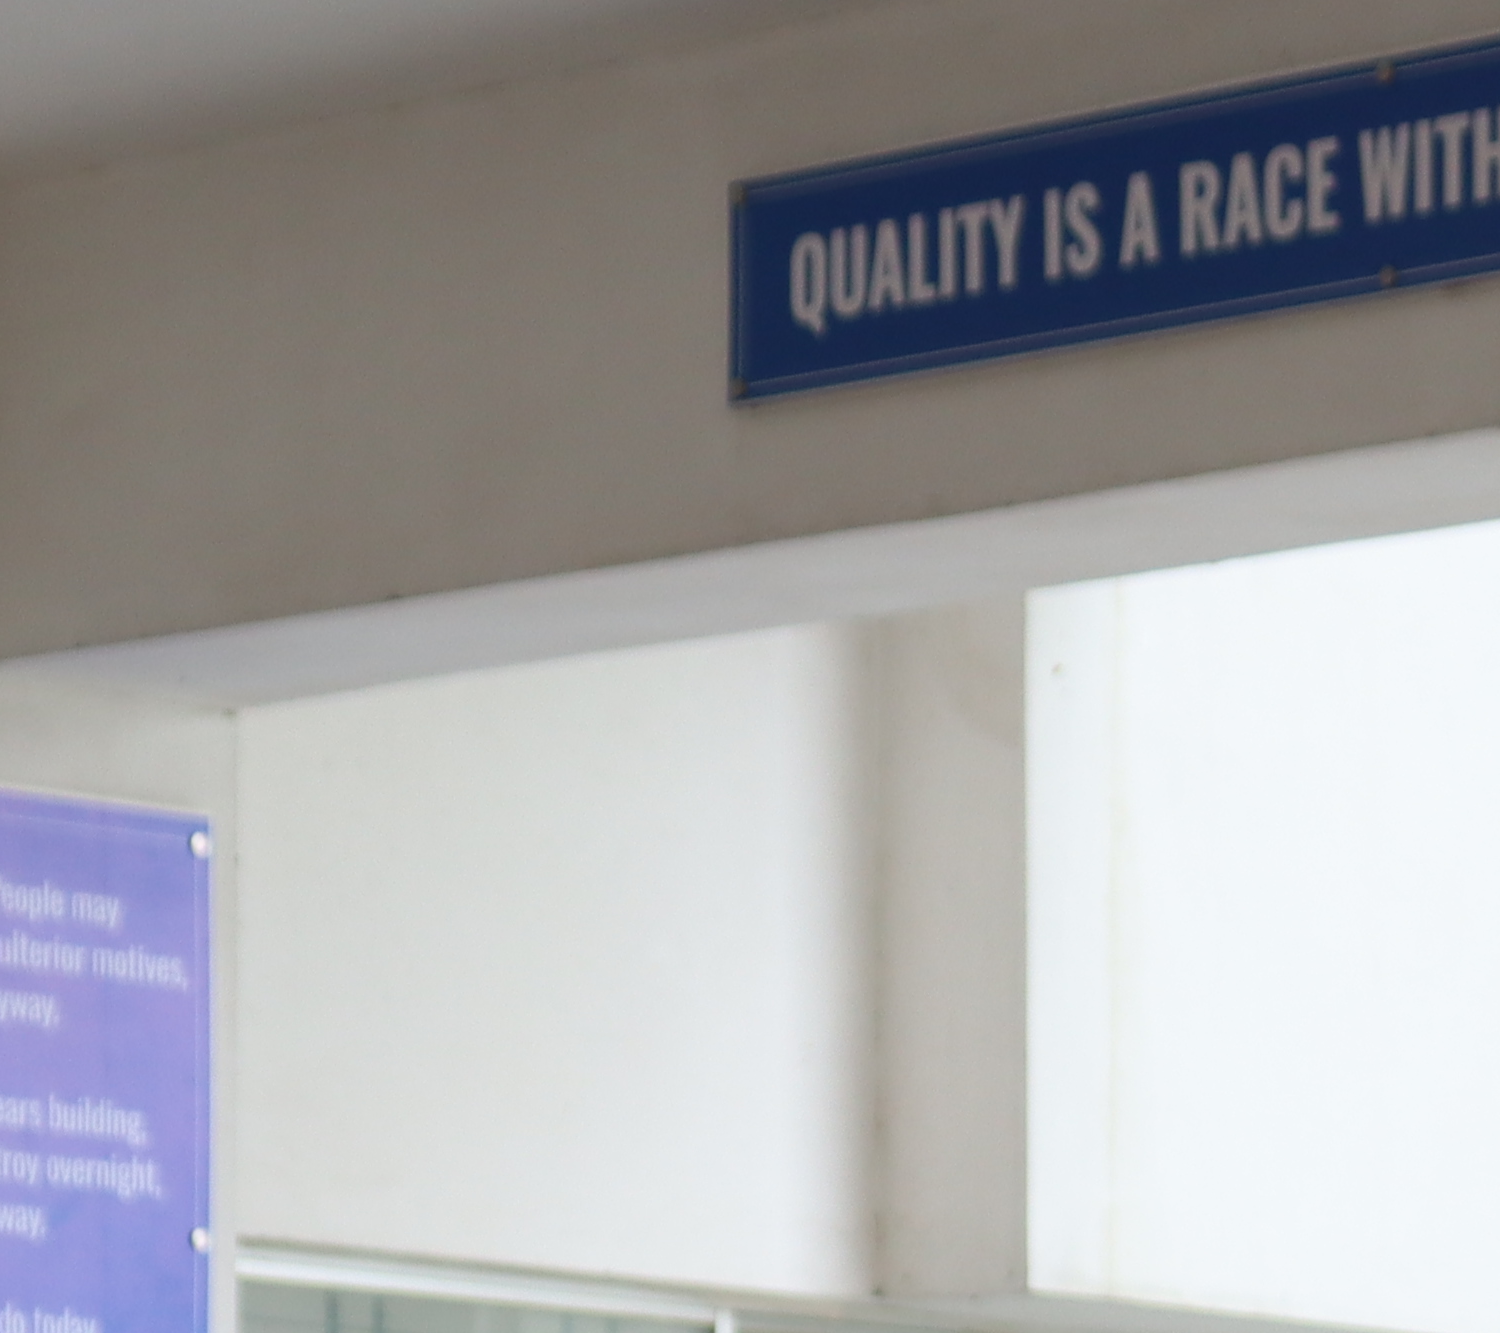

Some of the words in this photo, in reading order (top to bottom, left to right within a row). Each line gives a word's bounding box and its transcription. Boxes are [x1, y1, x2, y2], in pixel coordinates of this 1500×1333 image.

[789, 196, 1022, 333] QUALITY
[1042, 182, 1100, 281] IS
[1120, 172, 1159, 266] A
[1180, 135, 1339, 257] RACE
[72, 892, 120, 929] may
